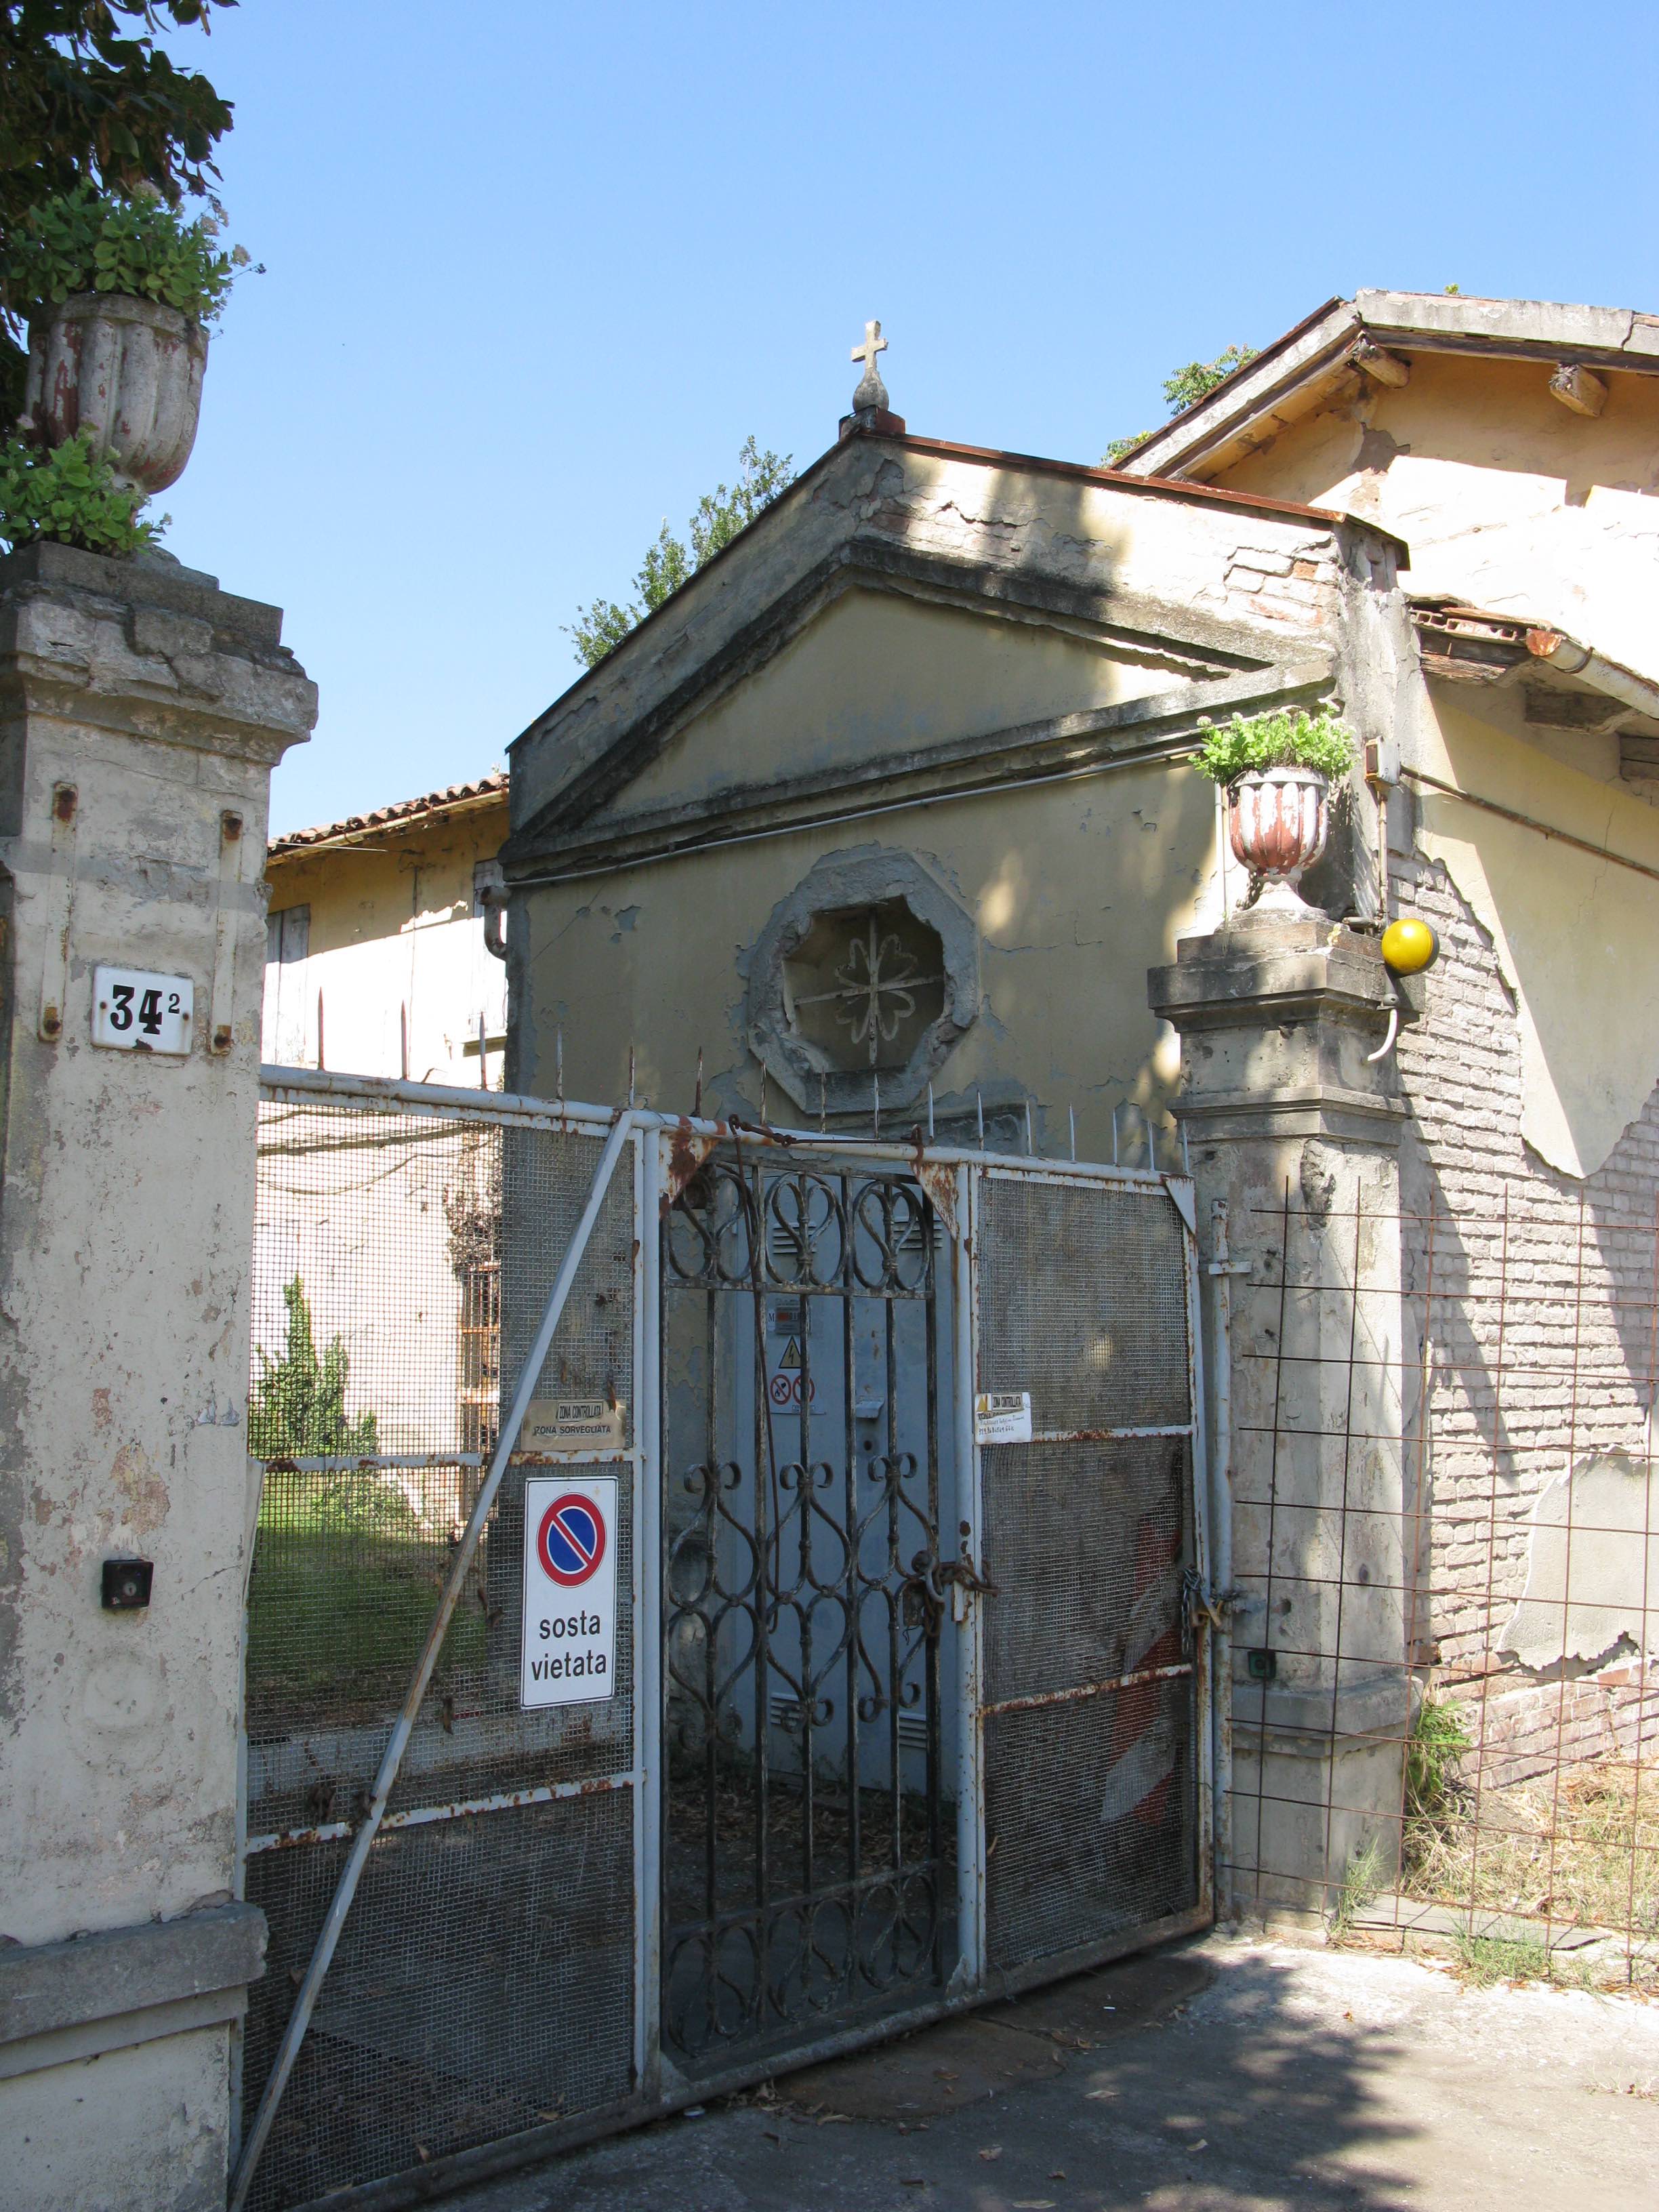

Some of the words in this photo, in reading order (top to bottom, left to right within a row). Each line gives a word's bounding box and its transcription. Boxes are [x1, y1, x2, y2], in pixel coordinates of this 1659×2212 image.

[559, 1406, 571, 1419] ZONA
[572, 1405, 601, 1418] CONTROLLATA
[535, 1426, 556, 1434] ZONA
[560, 1425, 611, 1434] SORVEGLIATA
[539, 1610, 601, 1640] sosta
[531, 1650, 607, 1681] vietata
